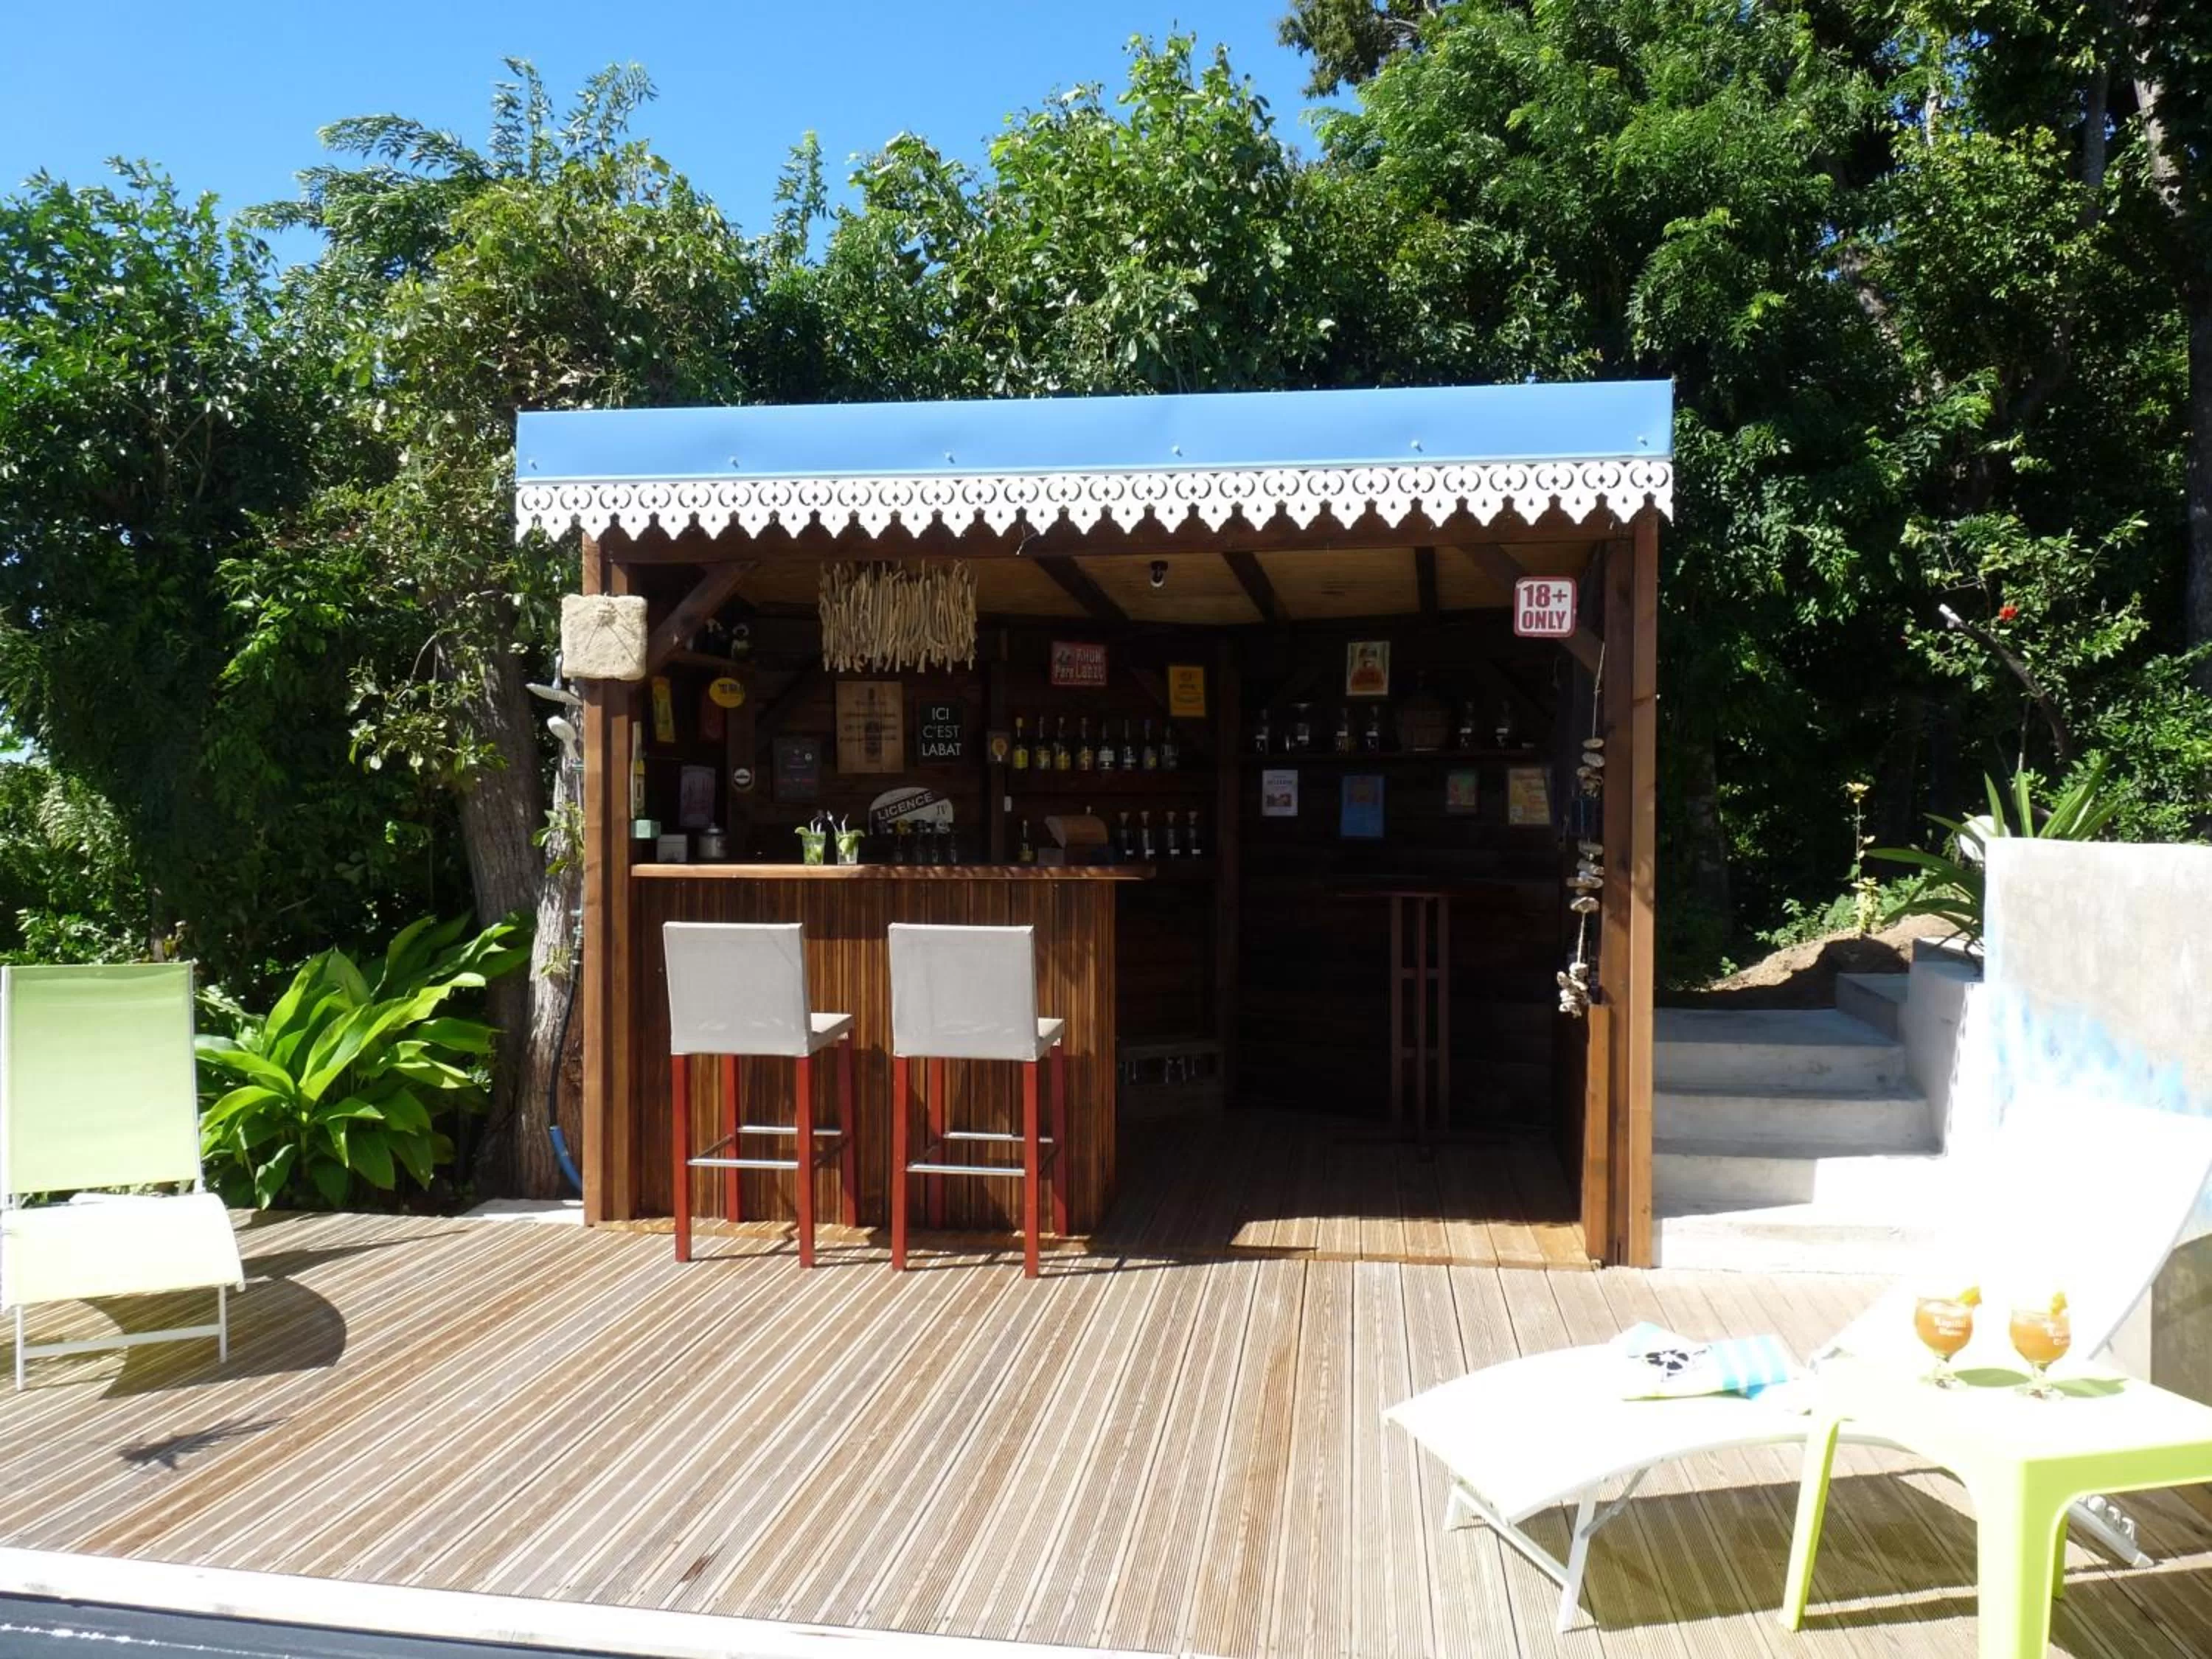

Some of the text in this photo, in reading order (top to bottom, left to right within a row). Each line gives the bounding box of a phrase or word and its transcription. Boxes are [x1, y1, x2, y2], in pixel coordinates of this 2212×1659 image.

[1523, 583, 1568, 608] 18+
[1521, 610, 1567, 630] ONLY
[931, 707, 950, 720] ICI
[922, 724, 961, 738] C'EST
[921, 742, 962, 756] LABAT
[877, 791, 933, 821] LICENCE
